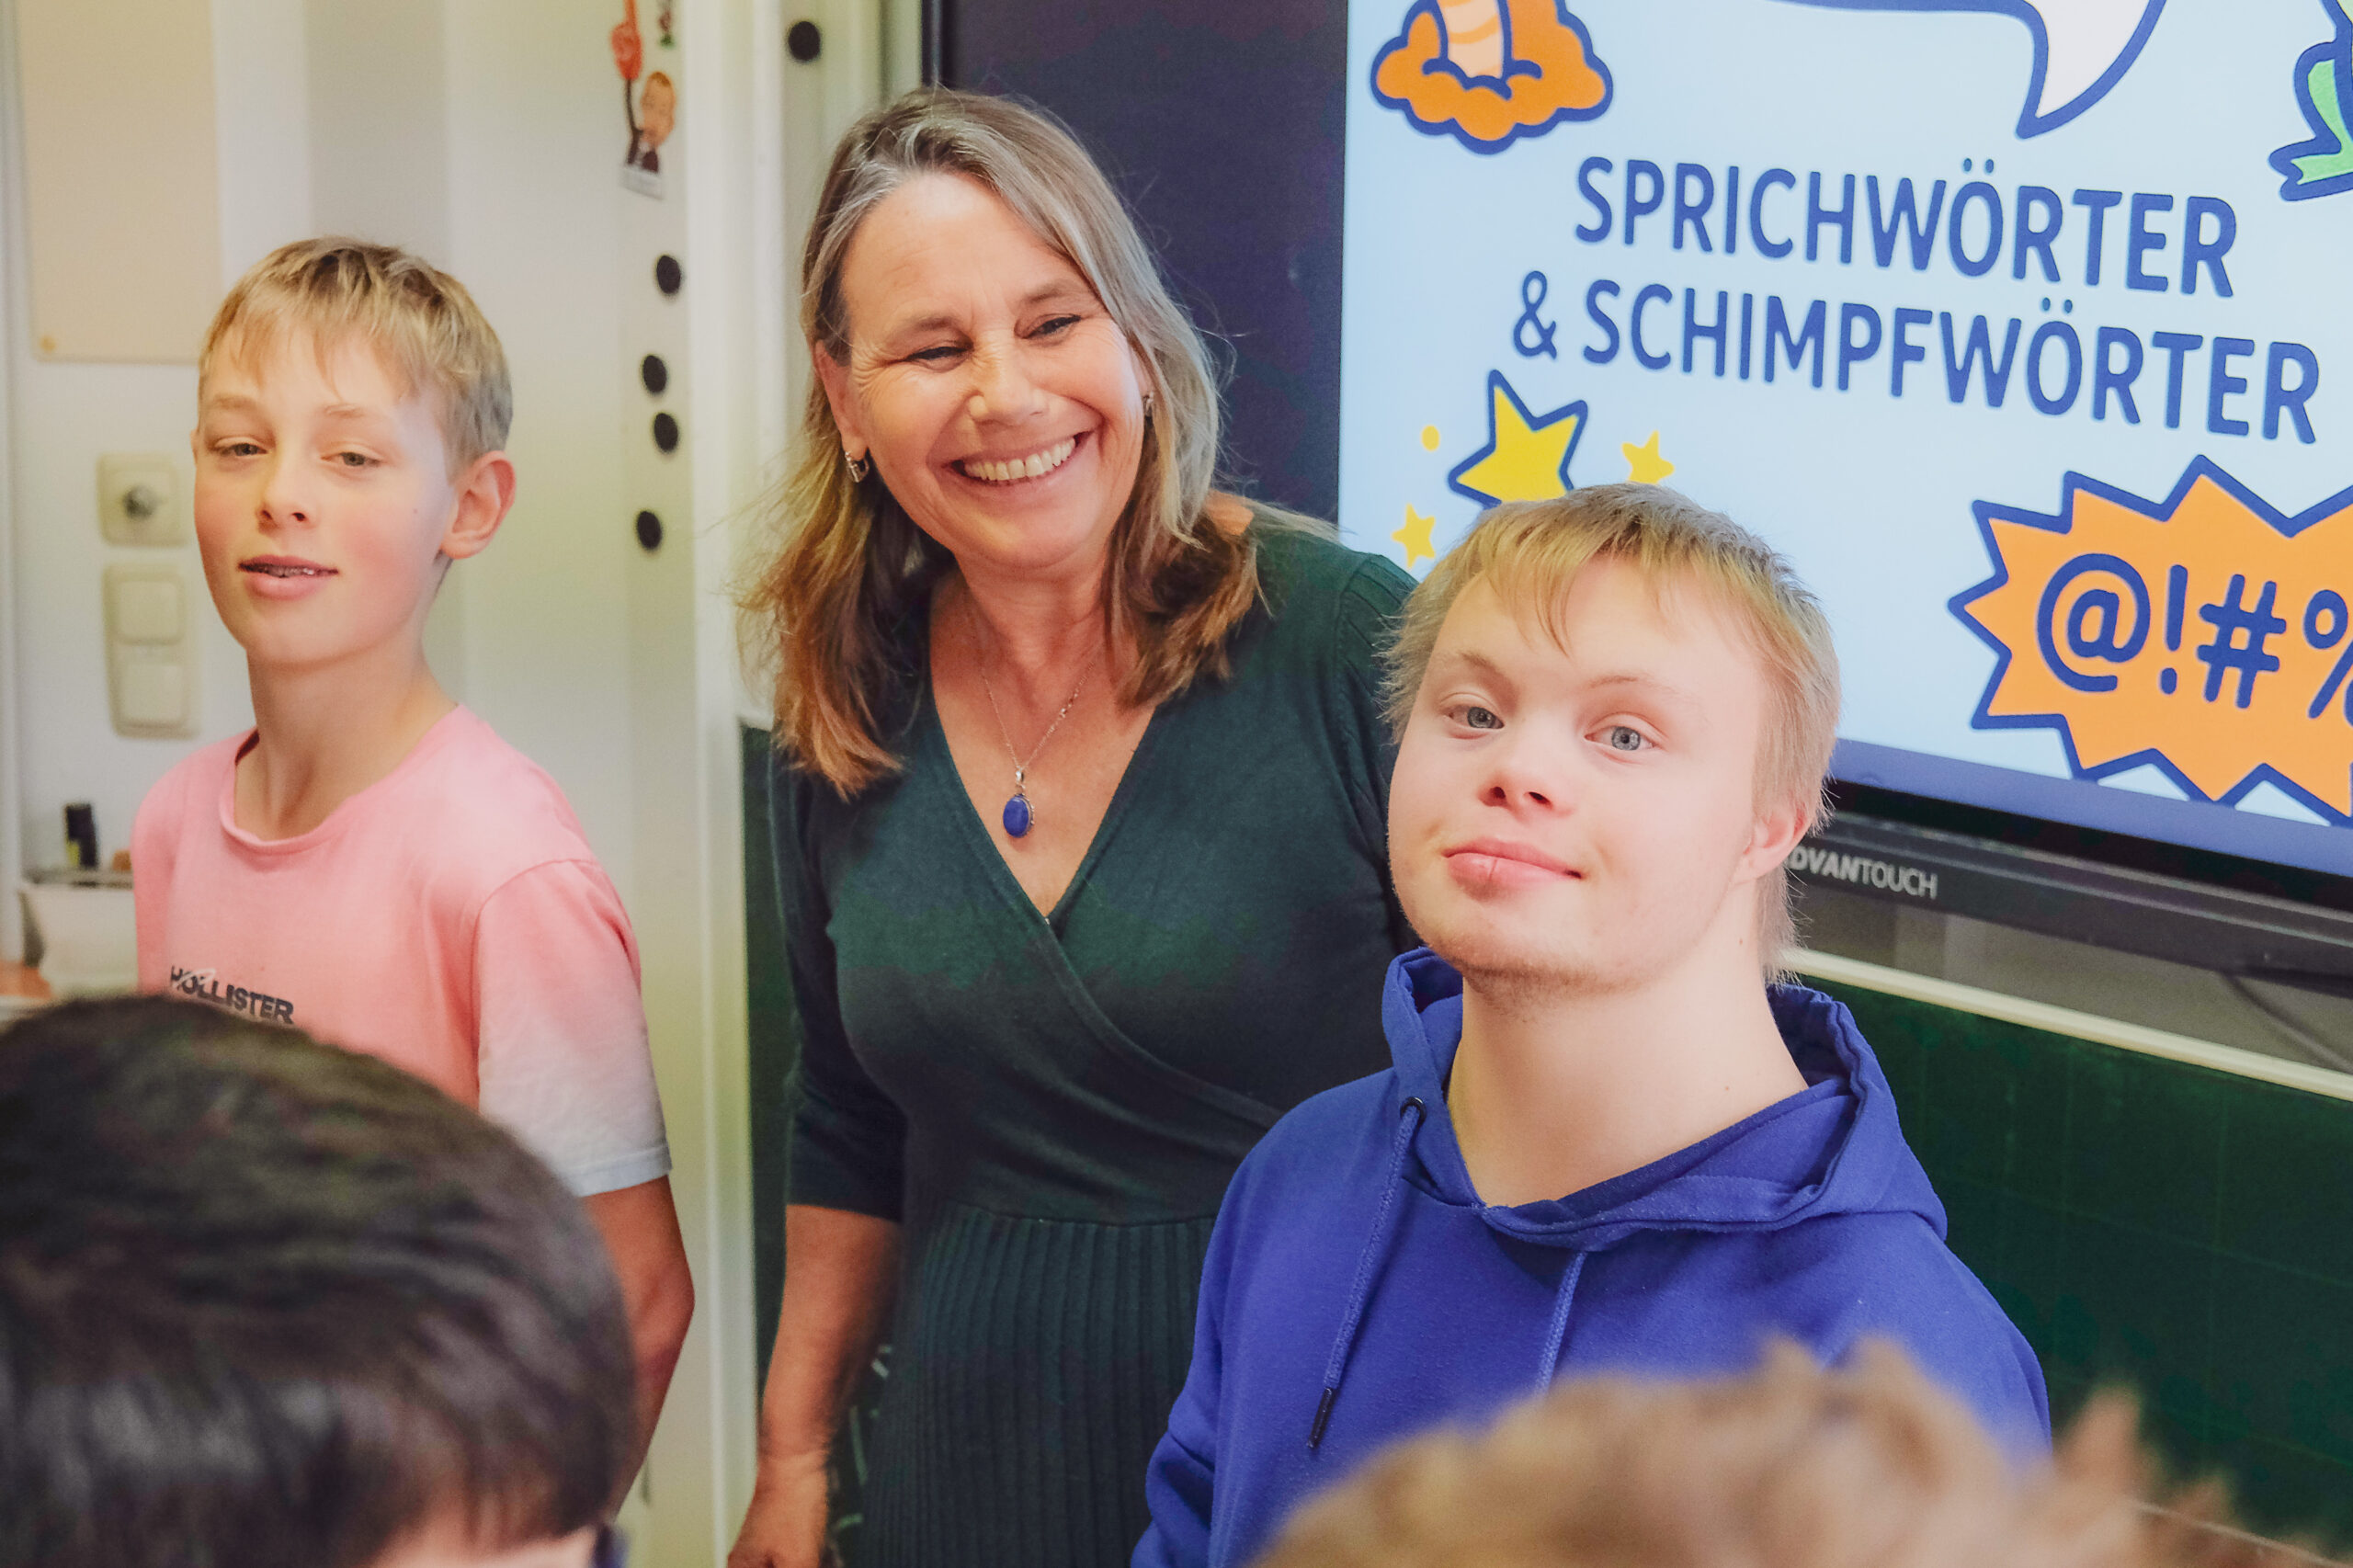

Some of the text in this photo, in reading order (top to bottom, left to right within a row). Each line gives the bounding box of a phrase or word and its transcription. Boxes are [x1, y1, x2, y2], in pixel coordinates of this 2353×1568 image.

[1575, 156, 2237, 299] SPRICHWÖRTER
[1513, 270, 2320, 445] & SCHIMPFWÖRTER
[1784, 844, 1938, 898] DVANTOUCH
[170, 965, 294, 1025] HOLLISTER
